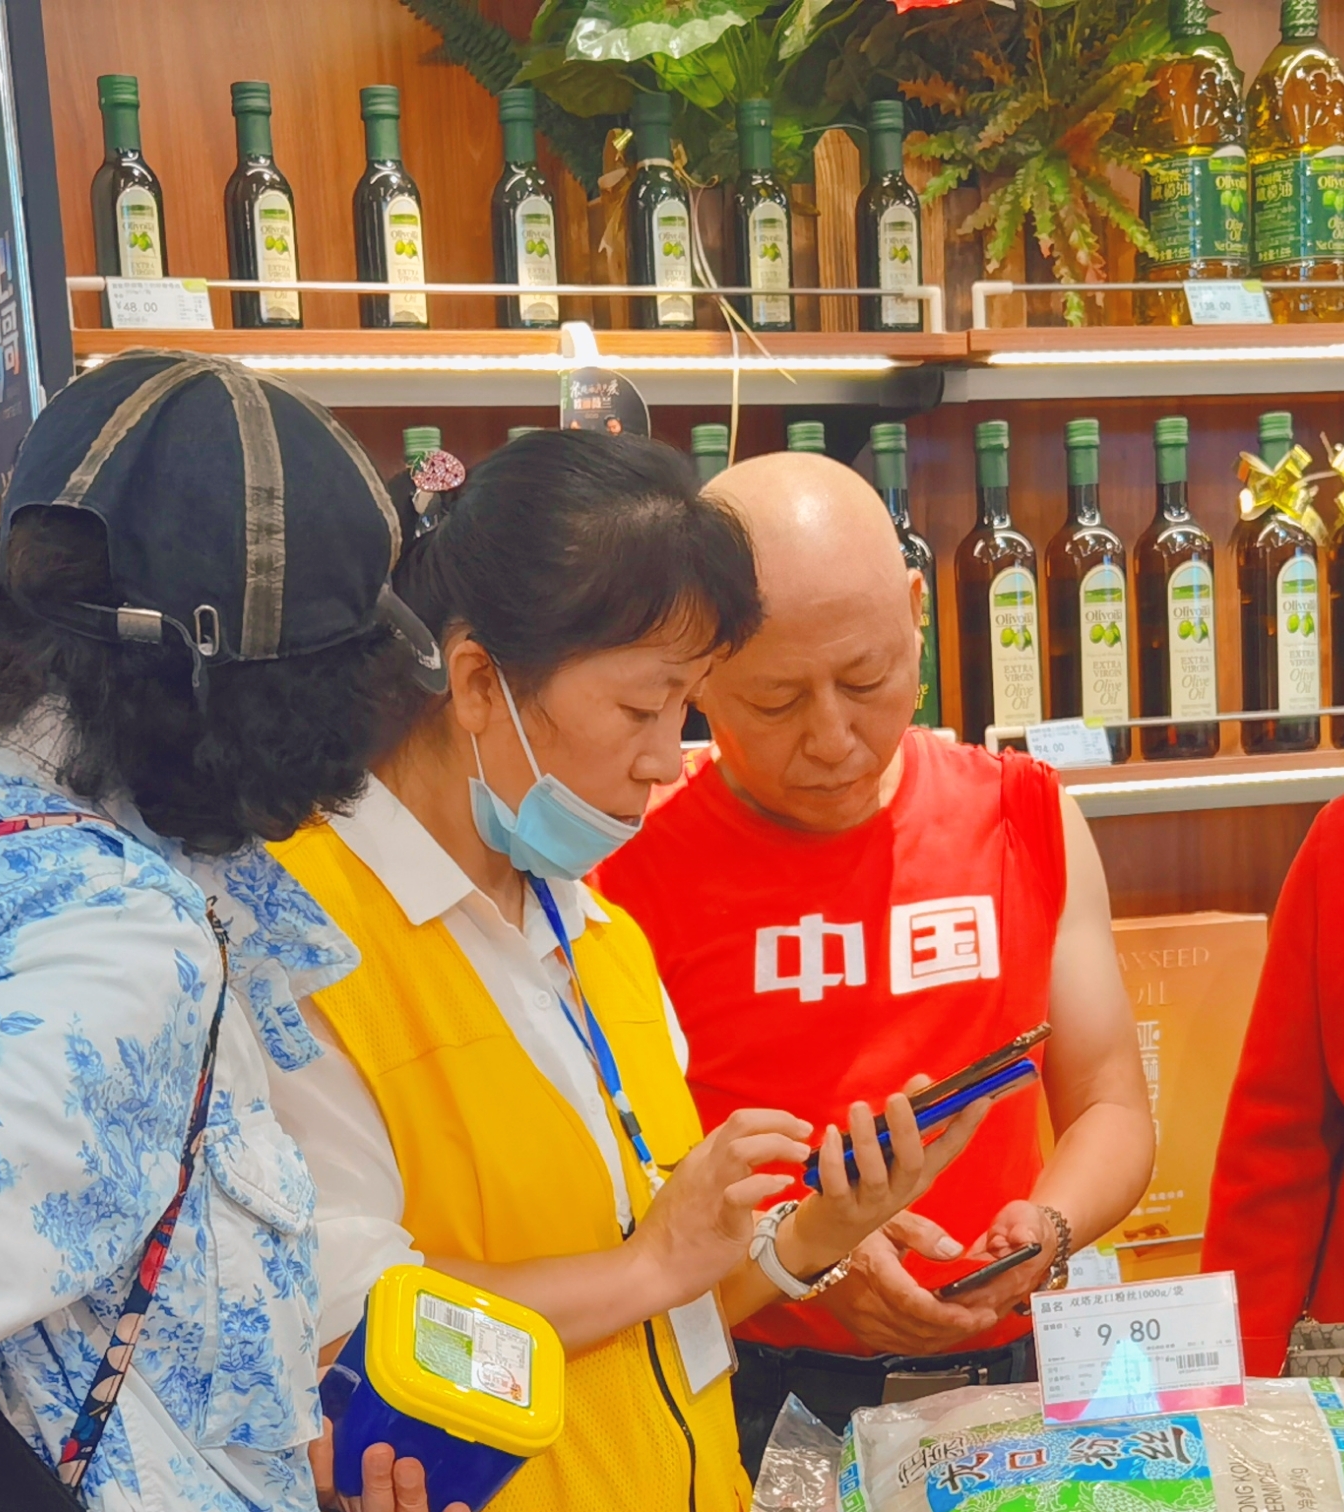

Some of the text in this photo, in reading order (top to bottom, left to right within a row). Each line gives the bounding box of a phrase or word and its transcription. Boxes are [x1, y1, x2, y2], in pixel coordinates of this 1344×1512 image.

[1092, 660, 1122, 670] EXTRA
[1180, 656, 1209, 665] EXTRA
[754, 894, 1001, 1003] 中国
[1137, 981, 1172, 1007] IL
[1040, 1300, 1064, 1314] 品名
[1072, 1318, 1161, 1347] ¥ 9.80
[937, 1425, 1191, 1493] 龙口粉丝
